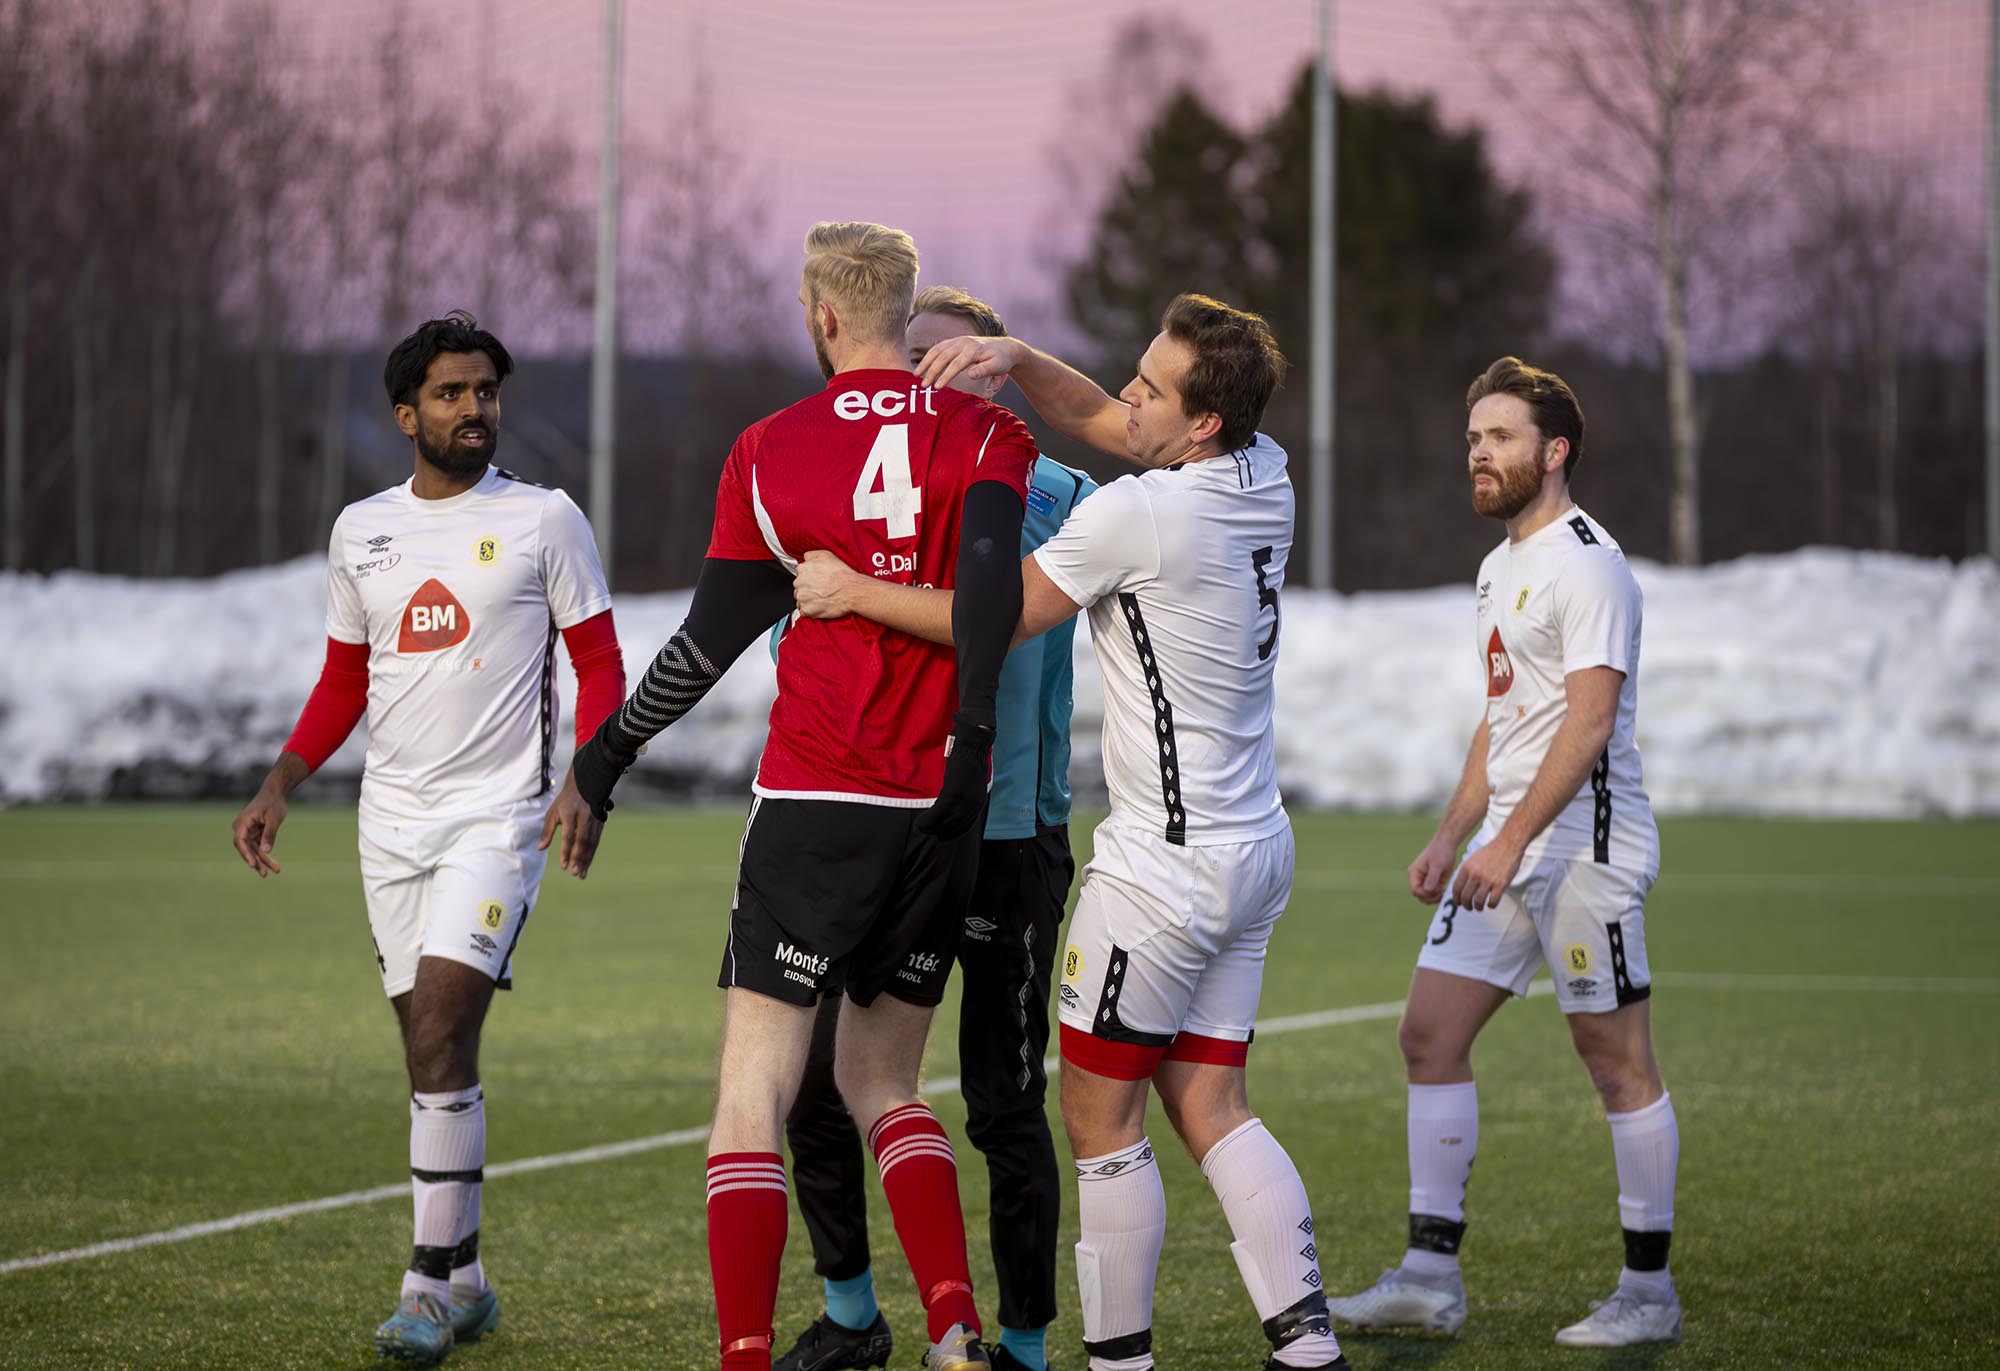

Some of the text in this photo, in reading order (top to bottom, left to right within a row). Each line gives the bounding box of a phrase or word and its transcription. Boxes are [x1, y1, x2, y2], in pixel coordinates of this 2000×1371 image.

[833, 384, 938, 421] ecit
[853, 423, 921, 539] 4
[1252, 545, 1278, 661] 5
[411, 605, 456, 632] BM
[1490, 652, 1510, 677] BM
[964, 929, 992, 942] umbro
[774, 941, 829, 975] Monté
[783, 969, 817, 988] EIDSVOL
[896, 968, 921, 984] SVOLL
